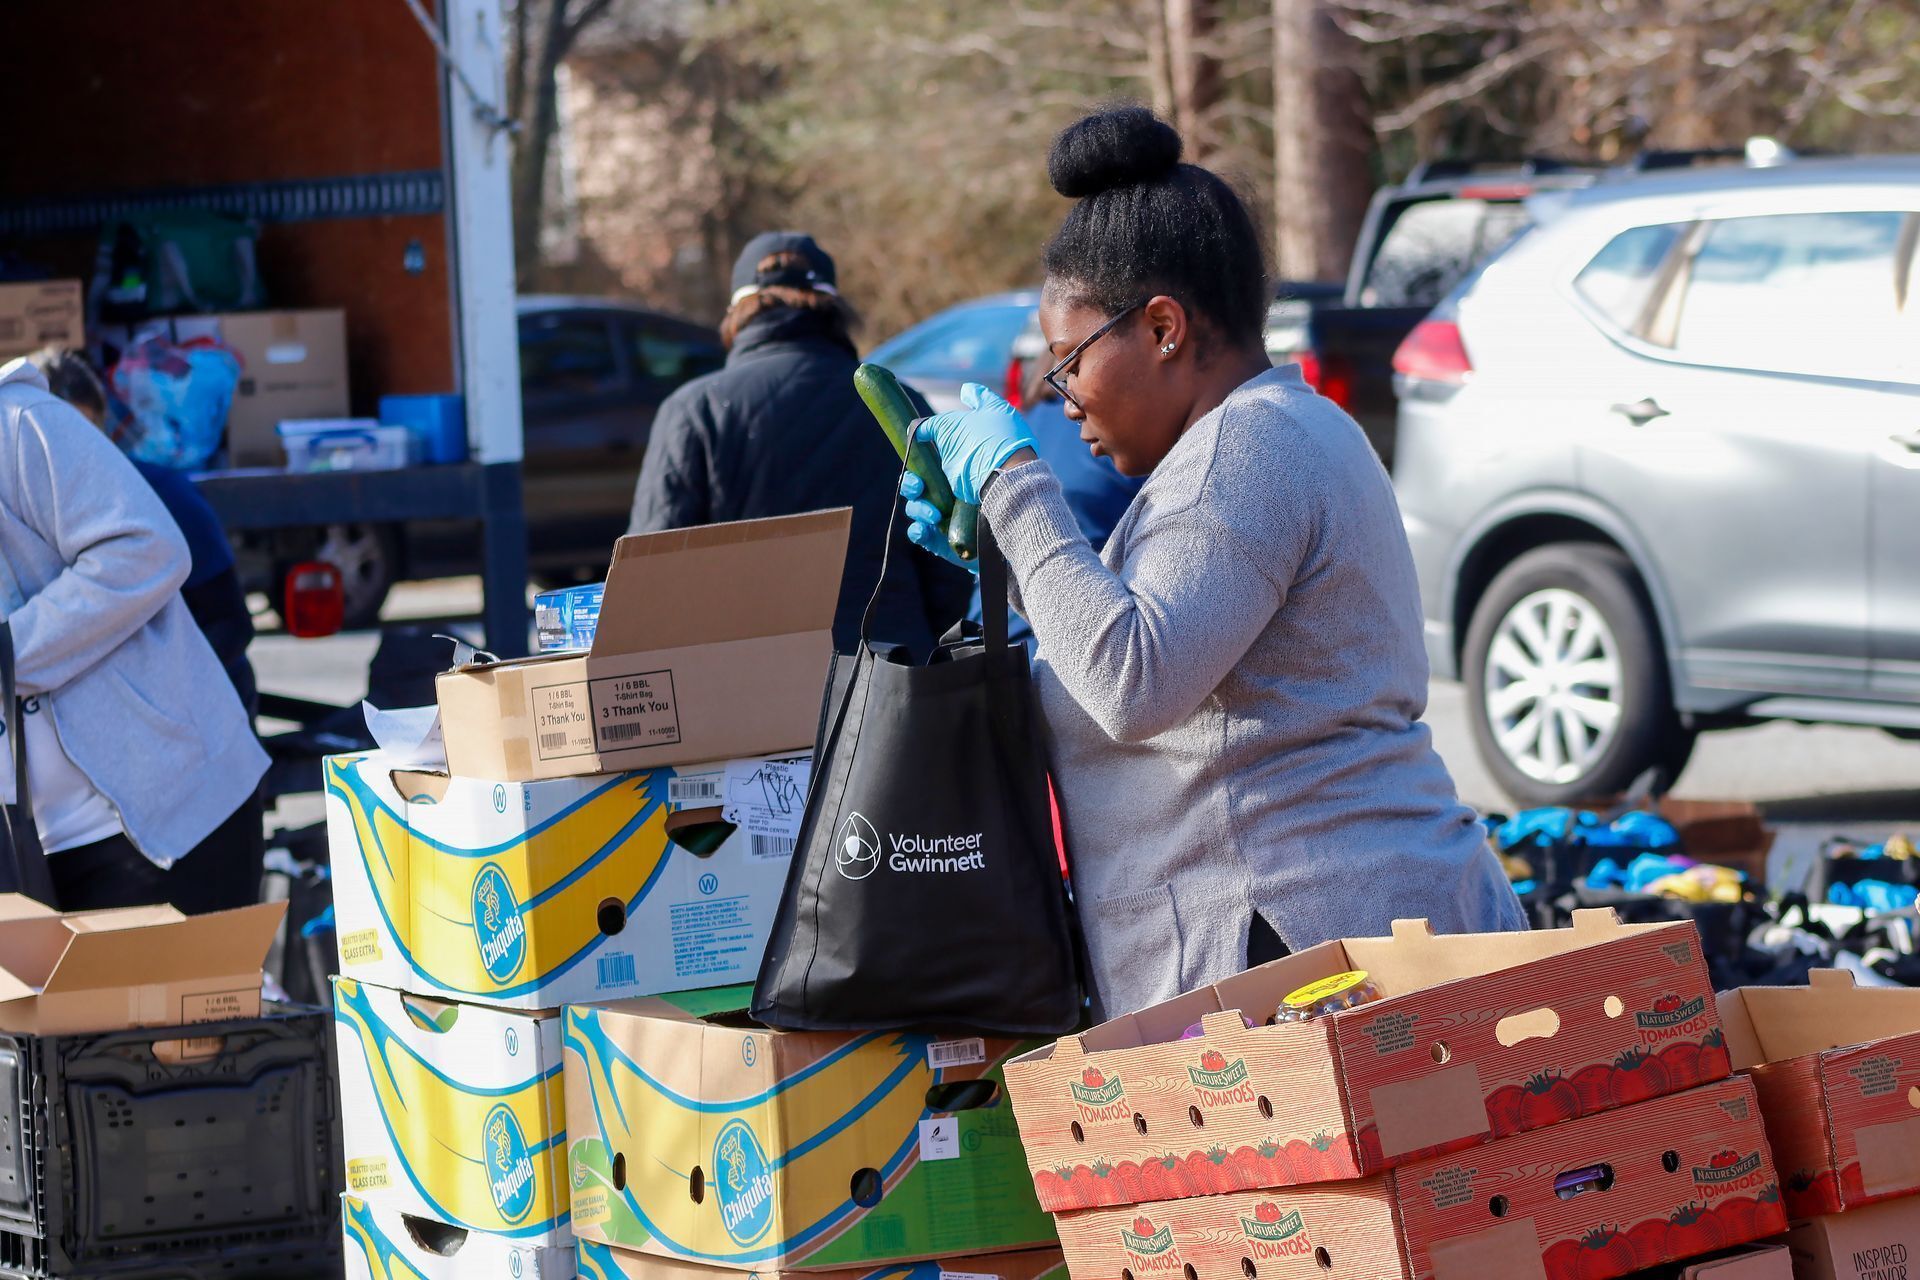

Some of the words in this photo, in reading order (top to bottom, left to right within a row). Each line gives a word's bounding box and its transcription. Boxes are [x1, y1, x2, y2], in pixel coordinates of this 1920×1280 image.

[560, 689, 572, 698] BBL
[633, 680, 650, 688] BBL
[549, 702, 564, 710] T-Shirt
[564, 701, 574, 709] Bag
[615, 692, 639, 701] T-Shirt
[541, 716, 546, 726] 3
[547, 713, 570, 725] Thank
[571, 712, 585, 722] You
[602, 708, 609, 718] 3
[612, 704, 646, 717] Thank
[648, 701, 668, 712] You
[765, 763, 789, 772] Plastic
[888, 833, 983, 853] Volunteer
[889, 850, 985, 873] Gwinnett
[344, 947, 359, 960] CLASS
[359, 945, 376, 957] EXTRA
[481, 914, 525, 971] Chiquita
[1641, 1000, 1701, 1025] NATURESWEET
[1638, 1013, 1708, 1045] TOMATOES
[1192, 1064, 1243, 1085] NATURESWEET
[1074, 1081, 1119, 1102] NATURESWEET
[1195, 1080, 1255, 1108] TOMATOES
[1077, 1098, 1131, 1123] TOMATOES
[1697, 1155, 1757, 1180] NATURESWEET
[352, 1177, 369, 1188] CLASS
[369, 1174, 388, 1185] EXTRA
[492, 1157, 533, 1209] Chiquita
[1695, 1170, 1764, 1200] TOMATOES
[723, 1173, 773, 1231] Chiquita
[1244, 1215, 1300, 1236] NATURESWEET
[1124, 1231, 1169, 1251] NATURESWEET
[1247, 1231, 1312, 1260] TOMATOES
[1128, 1247, 1182, 1272] TOMATOES
[1853, 1243, 1907, 1272] INSPIRED
